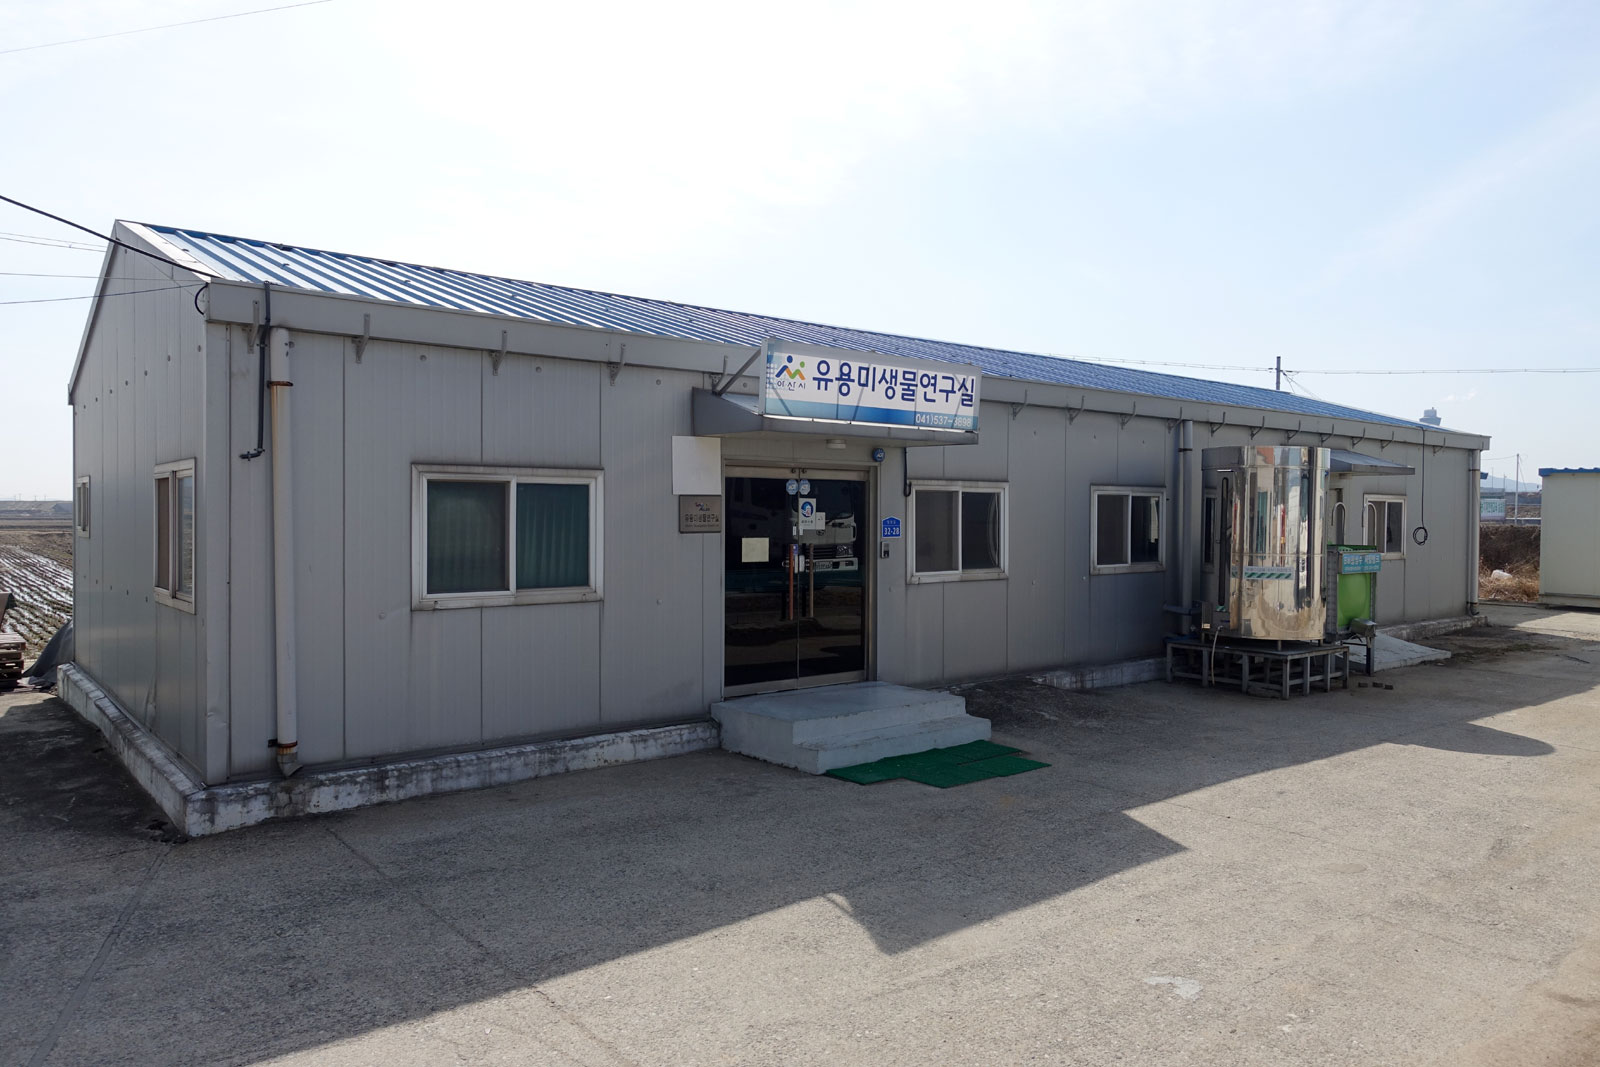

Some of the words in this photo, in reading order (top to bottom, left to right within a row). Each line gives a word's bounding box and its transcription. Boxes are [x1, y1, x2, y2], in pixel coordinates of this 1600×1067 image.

[776, 380, 806, 391] 아산시
[812, 359, 975, 407] 유용미생물연구실
[884, 527, 900, 535] 32-28
